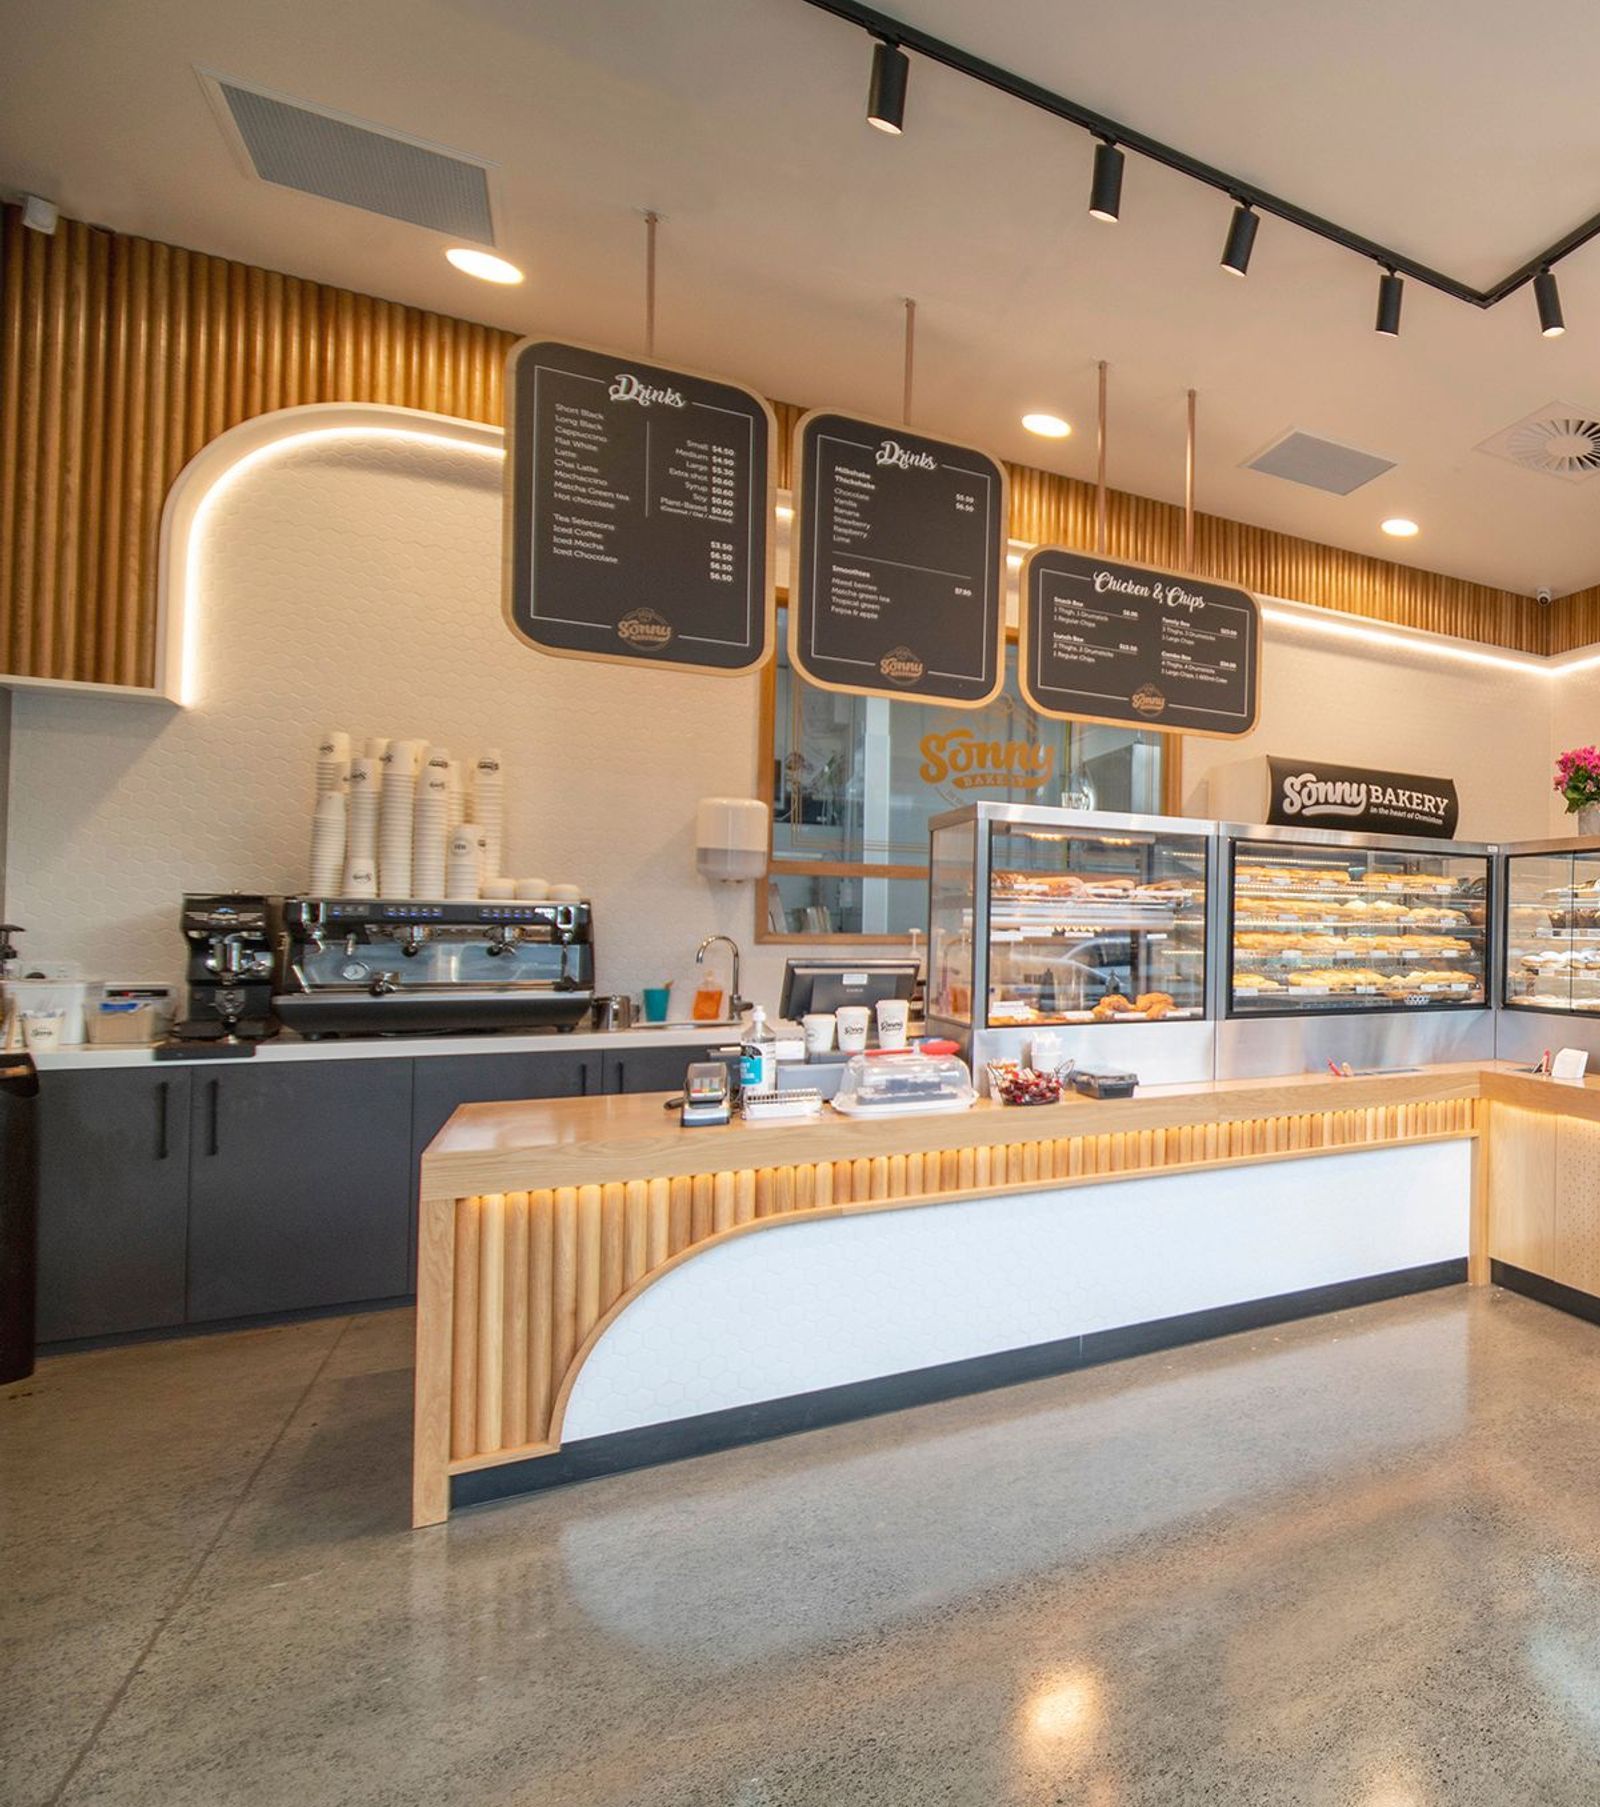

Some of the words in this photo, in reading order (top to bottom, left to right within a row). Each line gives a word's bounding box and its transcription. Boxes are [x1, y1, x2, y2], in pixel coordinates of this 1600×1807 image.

[608, 374, 686, 408] Drinks
[555, 414, 579, 427] Long
[555, 447, 578, 458] Latte
[572, 440, 599, 452] White
[875, 440, 938, 470] Drinks
[554, 459, 575, 469] Chai
[576, 463, 599, 473] Latte
[554, 481, 587, 493] Matcha
[588, 487, 615, 499] Green
[554, 491, 571, 502] Hot
[553, 513, 570, 523] Tea
[571, 516, 616, 532] Selections
[833, 515, 872, 531] Strawberry
[553, 524, 573, 535] Iced
[574, 528, 604, 540] Coffee
[833, 525, 868, 539] Raspberry
[833, 534, 851, 544] Lime
[574, 539, 605, 551] Mocha
[553, 547, 573, 557] Iced
[573, 550, 619, 564] Chocolate
[1093, 571, 1151, 598] Chicken
[1152, 582, 1164, 604] &
[1165, 585, 1207, 614] Chips
[617, 619, 672, 641] Sonny
[880, 657, 924, 678] Sonny
[1131, 692, 1166, 710] Sonny
[919, 728, 1054, 790] Sonny
[1282, 773, 1368, 817] Sonny
[1368, 784, 1449, 816] BAKERY
[1379, 807, 1389, 816] the
[1389, 808, 1407, 818] heart
[1407, 811, 1415, 820] of
